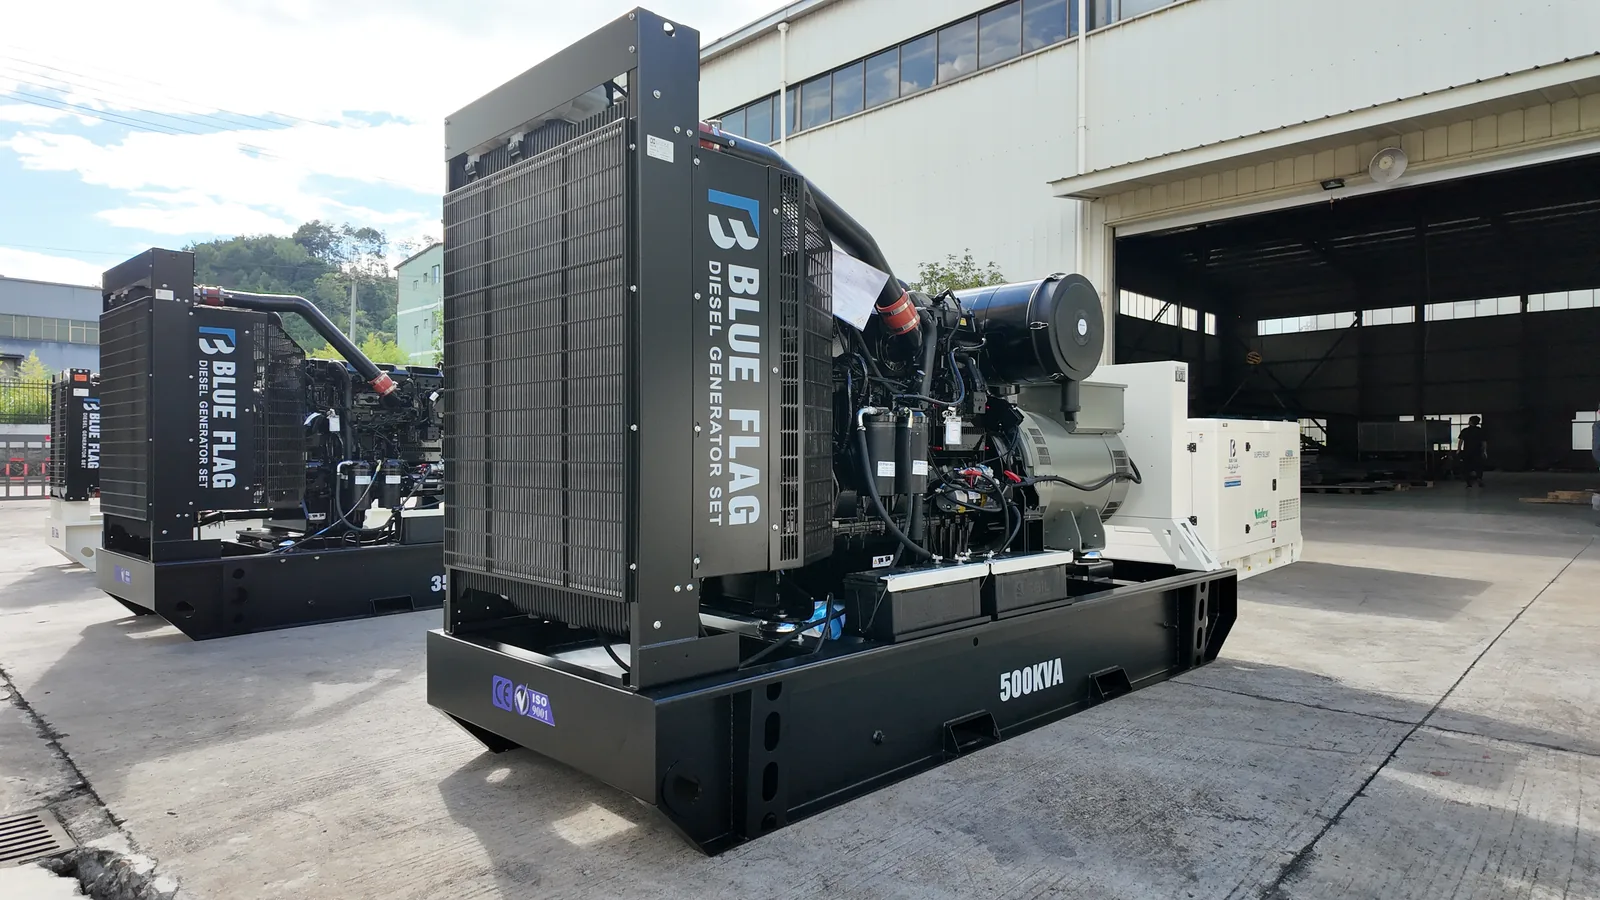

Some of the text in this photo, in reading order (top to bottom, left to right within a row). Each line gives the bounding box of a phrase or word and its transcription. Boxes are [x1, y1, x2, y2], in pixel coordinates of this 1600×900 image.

[198, 360, 209, 489] DIESEL GENERATOR SET
[212, 361, 236, 489] BLUE FLAG
[709, 260, 722, 526] DIESEL GENERATOR SET
[728, 264, 760, 526] BLUE FLAG
[87, 412, 100, 469] BLUE FLAG
[531, 705, 549, 721] 9001
[532, 693, 547, 707] ISO
[1000, 657, 1064, 702] 500KVA
